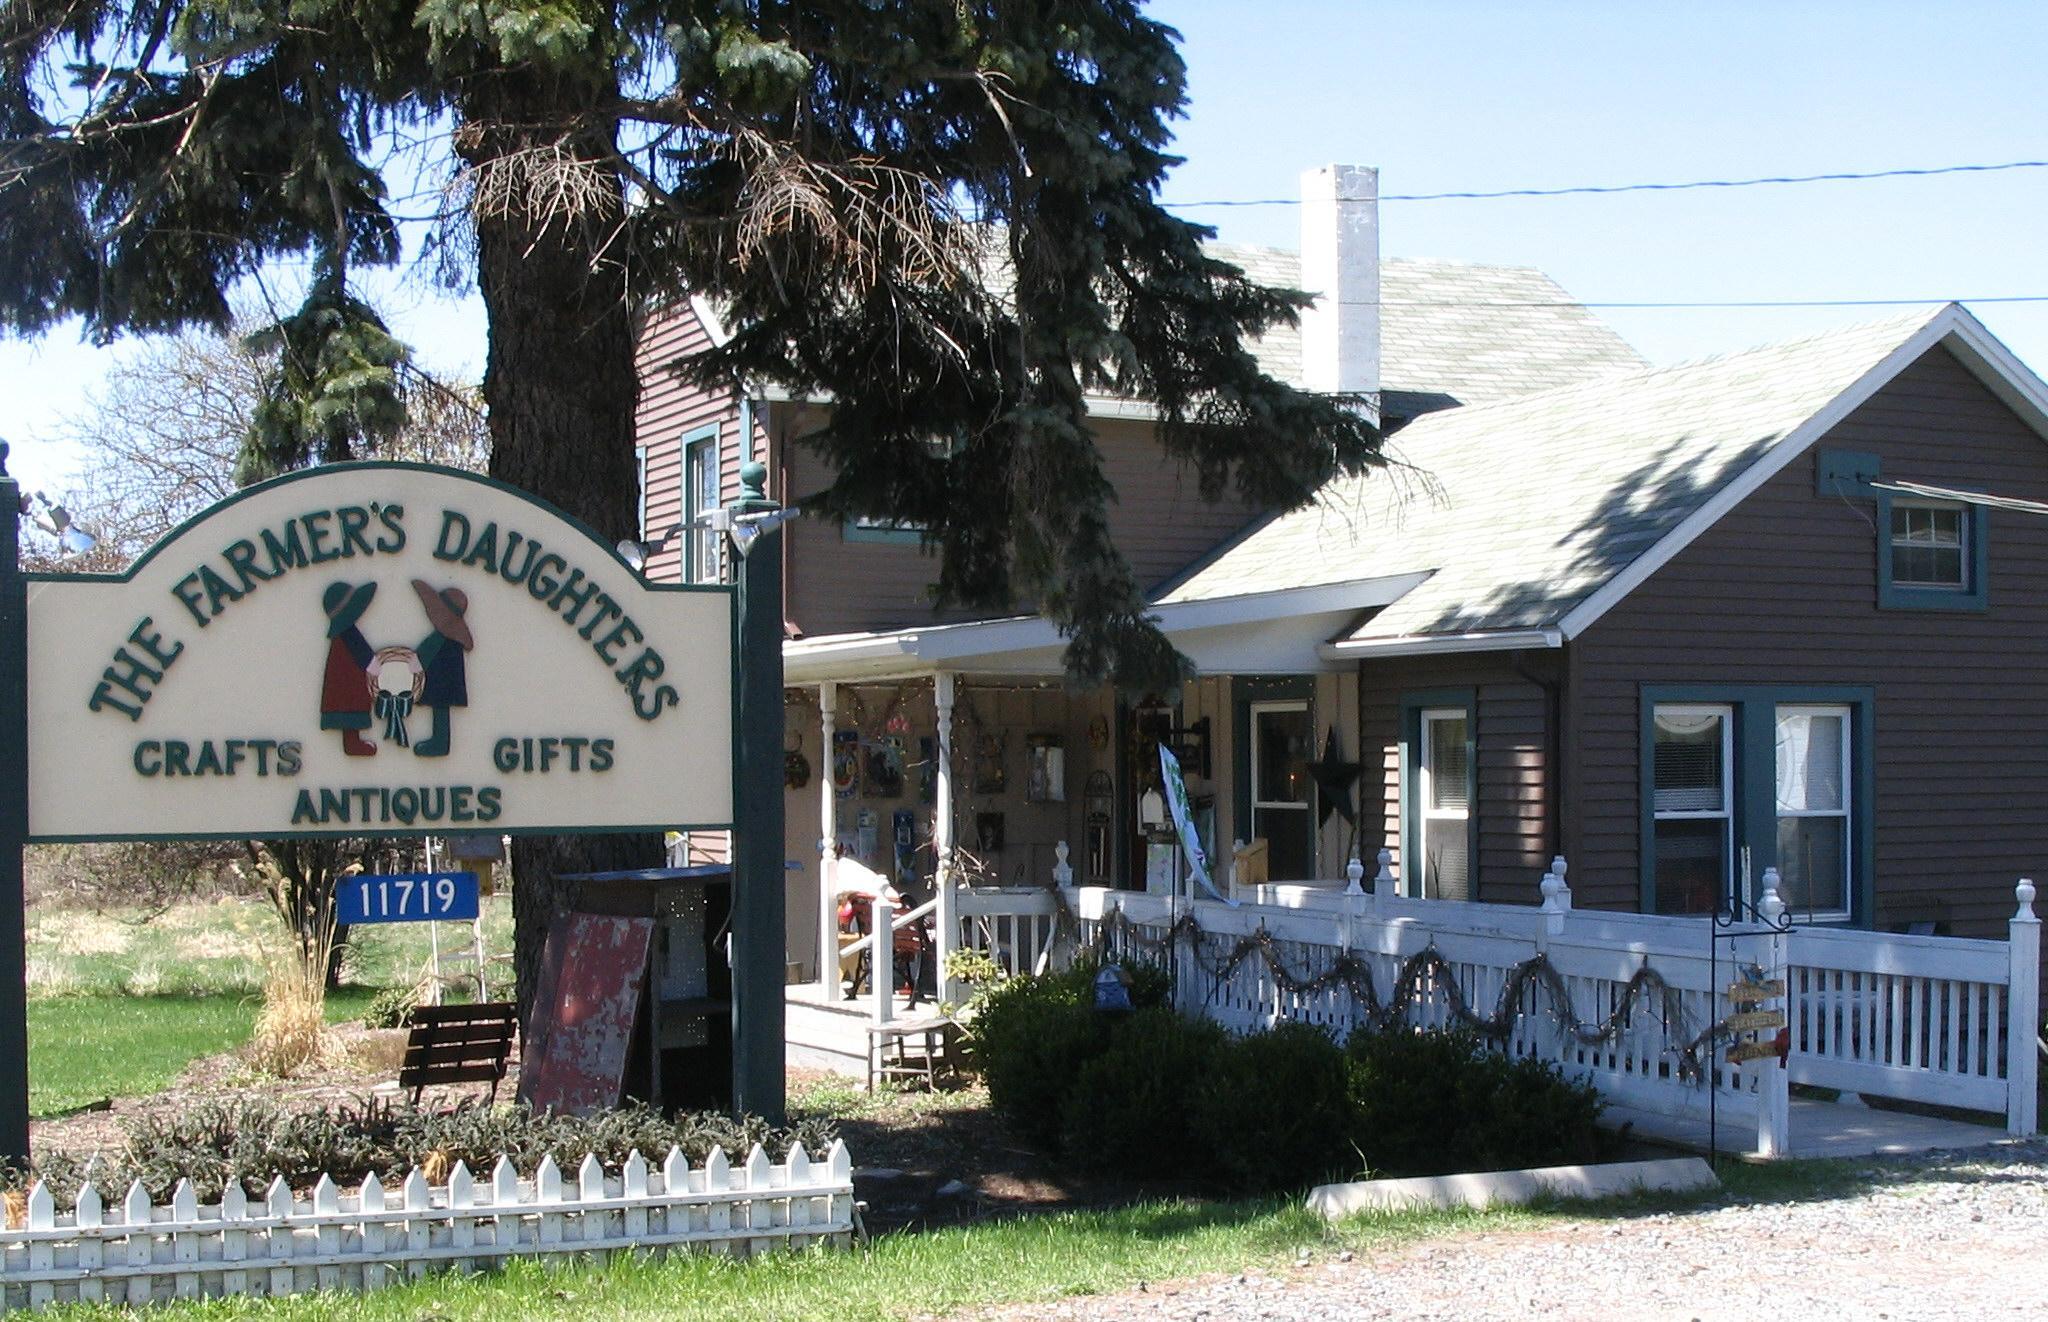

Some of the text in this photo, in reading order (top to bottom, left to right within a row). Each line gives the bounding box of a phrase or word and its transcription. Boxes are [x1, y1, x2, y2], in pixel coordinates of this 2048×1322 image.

[89, 501, 679, 721] THE FARMER'S DAUGHTERS
[134, 741, 302, 776] CRAFTS
[494, 738, 614, 773] GIFTS
[292, 788, 502, 824] ANTIQUES
[360, 878, 456, 917] 11719
